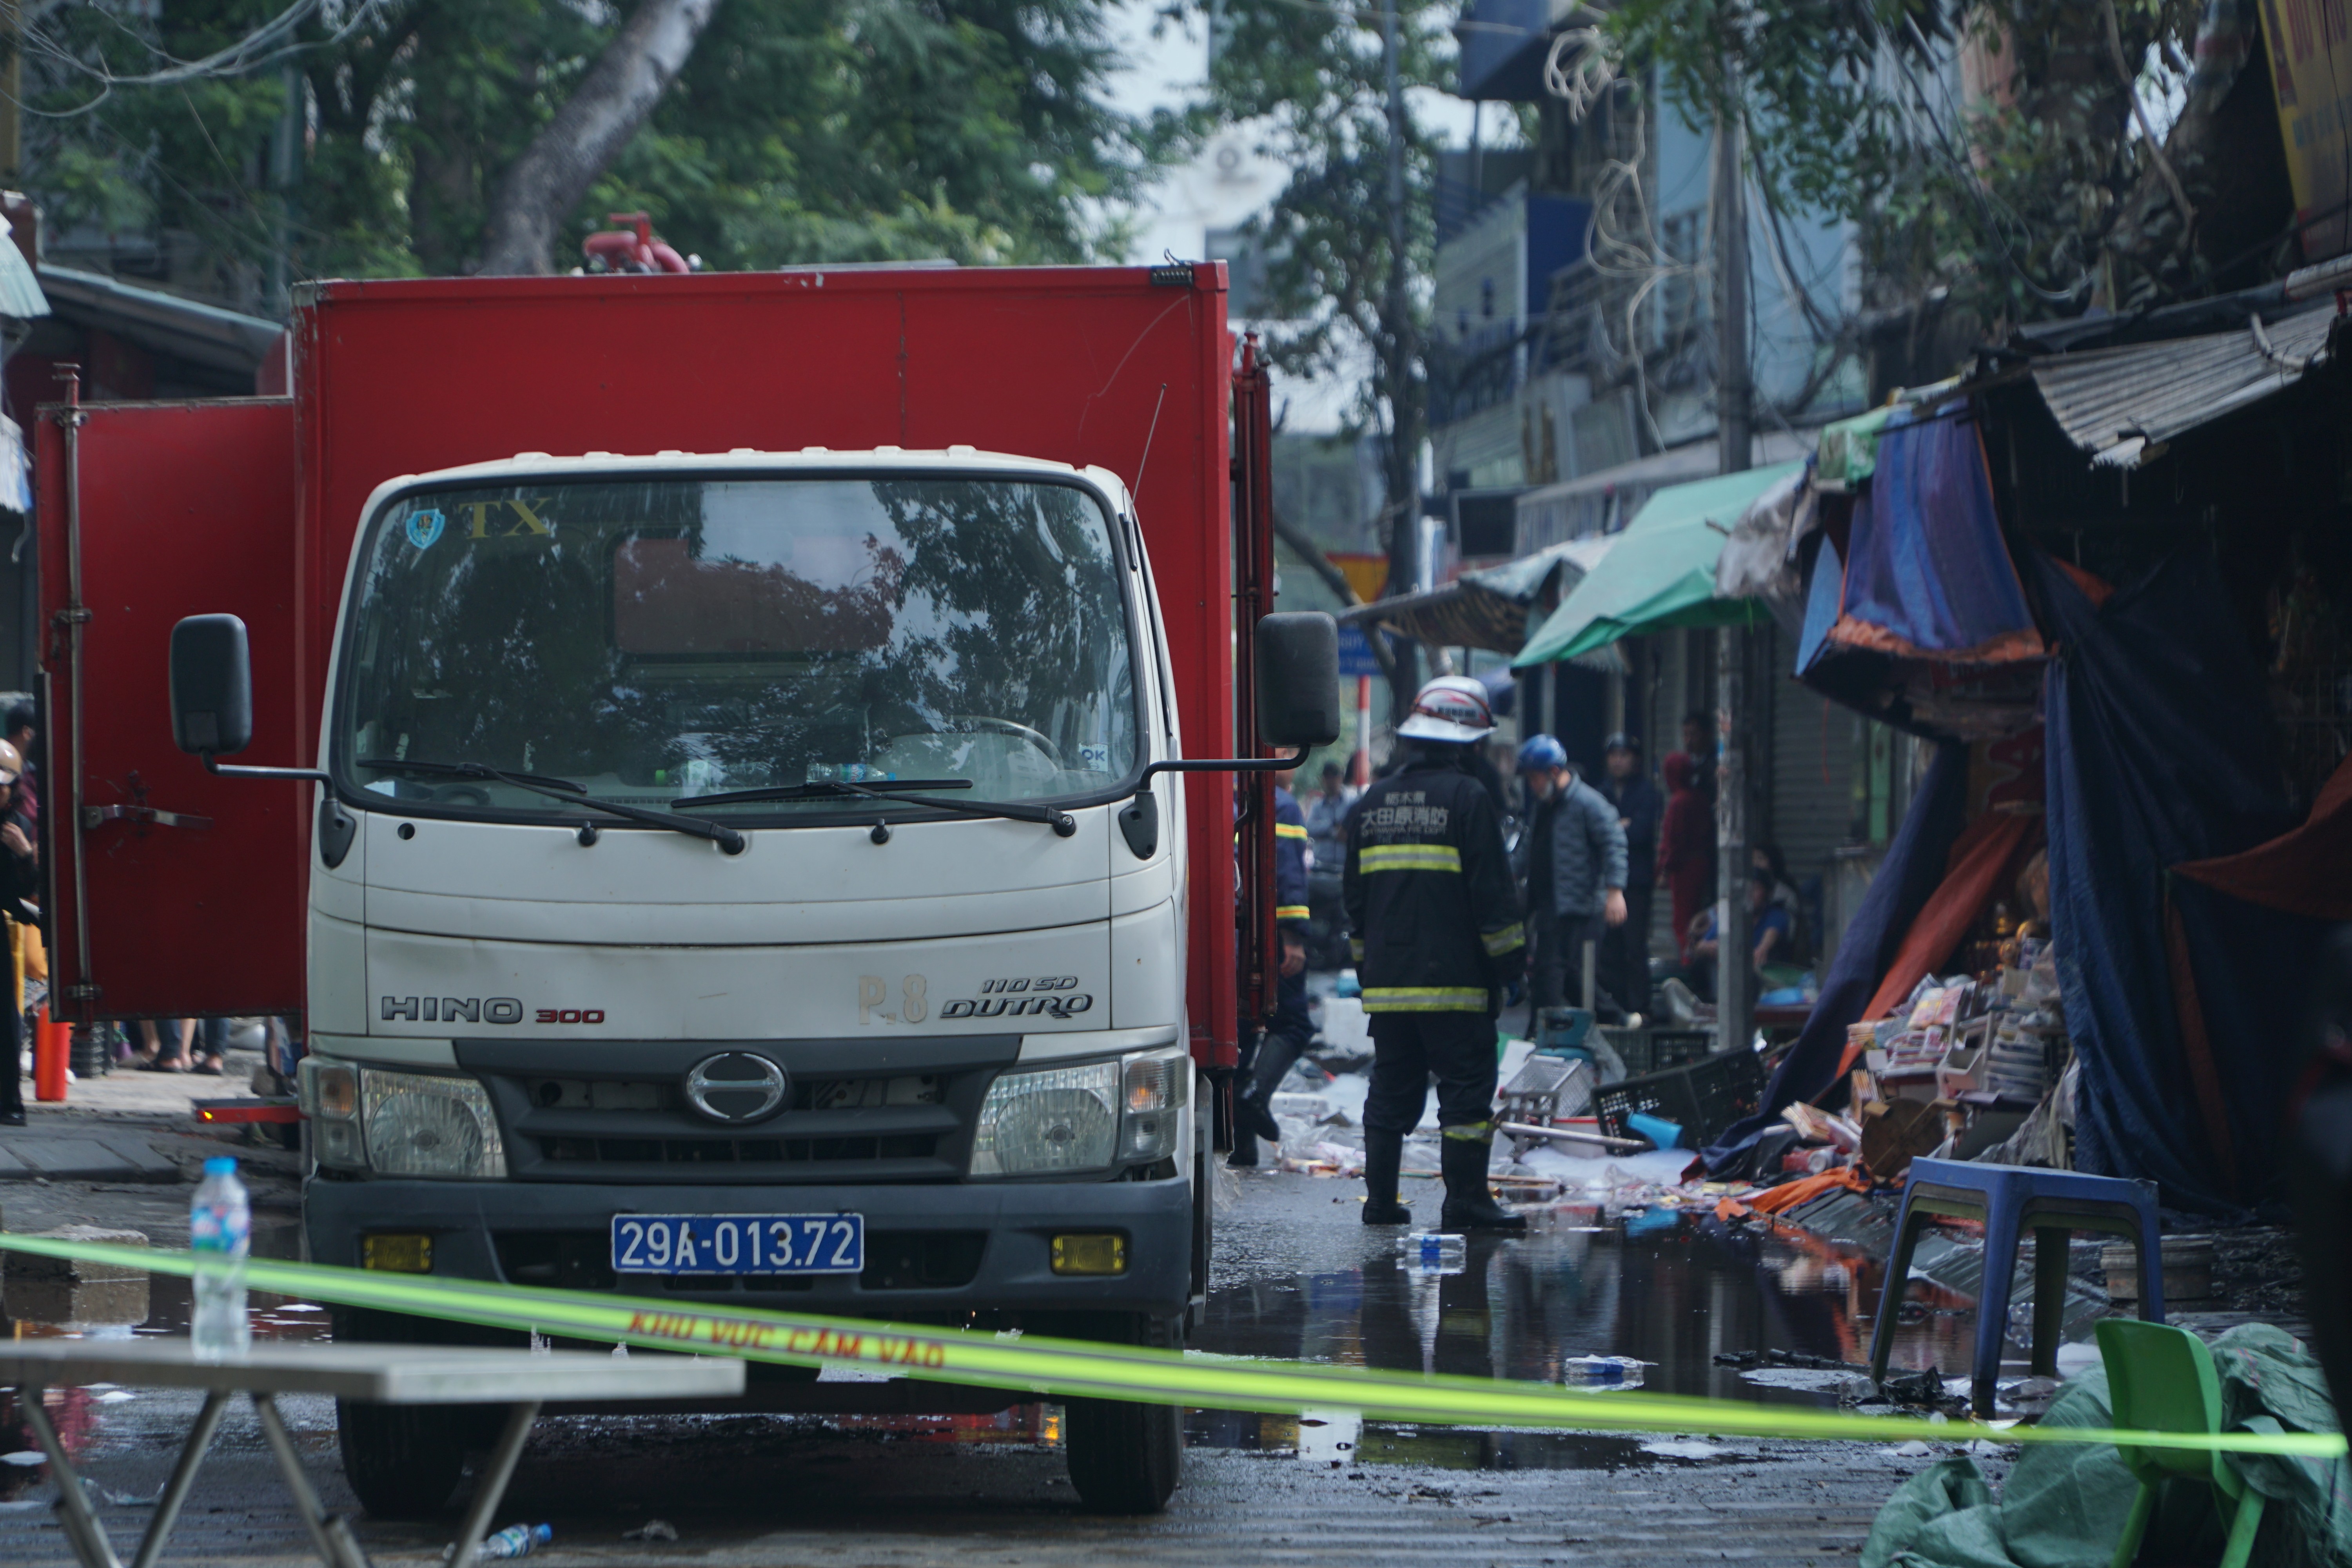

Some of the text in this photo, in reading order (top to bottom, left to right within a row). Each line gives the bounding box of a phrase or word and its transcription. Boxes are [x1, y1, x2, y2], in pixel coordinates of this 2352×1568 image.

[458, 497, 553, 539] TX
[1082, 749, 1105, 762] OK
[381, 996, 605, 1024] HINO 300
[940, 994, 1094, 1019] DUTRO
[620, 1221, 855, 1267] 29A-013.72
[628, 1310, 698, 1340] KHU
